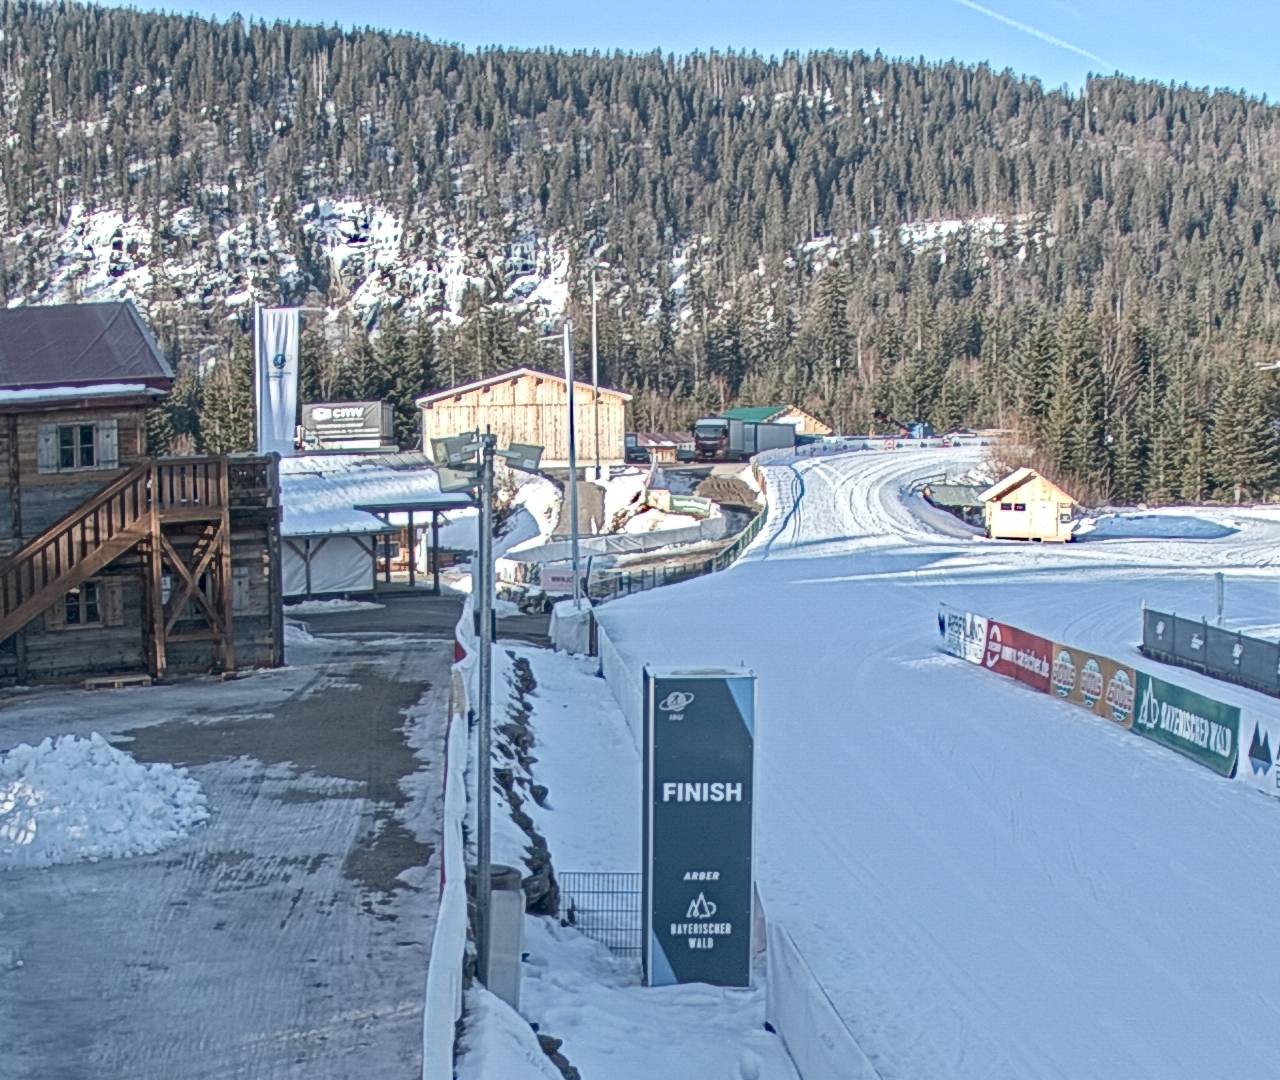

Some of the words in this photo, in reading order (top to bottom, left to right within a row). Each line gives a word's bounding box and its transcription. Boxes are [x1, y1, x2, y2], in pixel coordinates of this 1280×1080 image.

[1160, 702, 1209, 746] BAYERISCHER
[1209, 722, 1232, 758] WALD
[662, 782, 742, 802] FINISH
[683, 871, 720, 881] ARBER
[670, 923, 732, 935] BAYERISCHER
[688, 937, 714, 949] WALD
